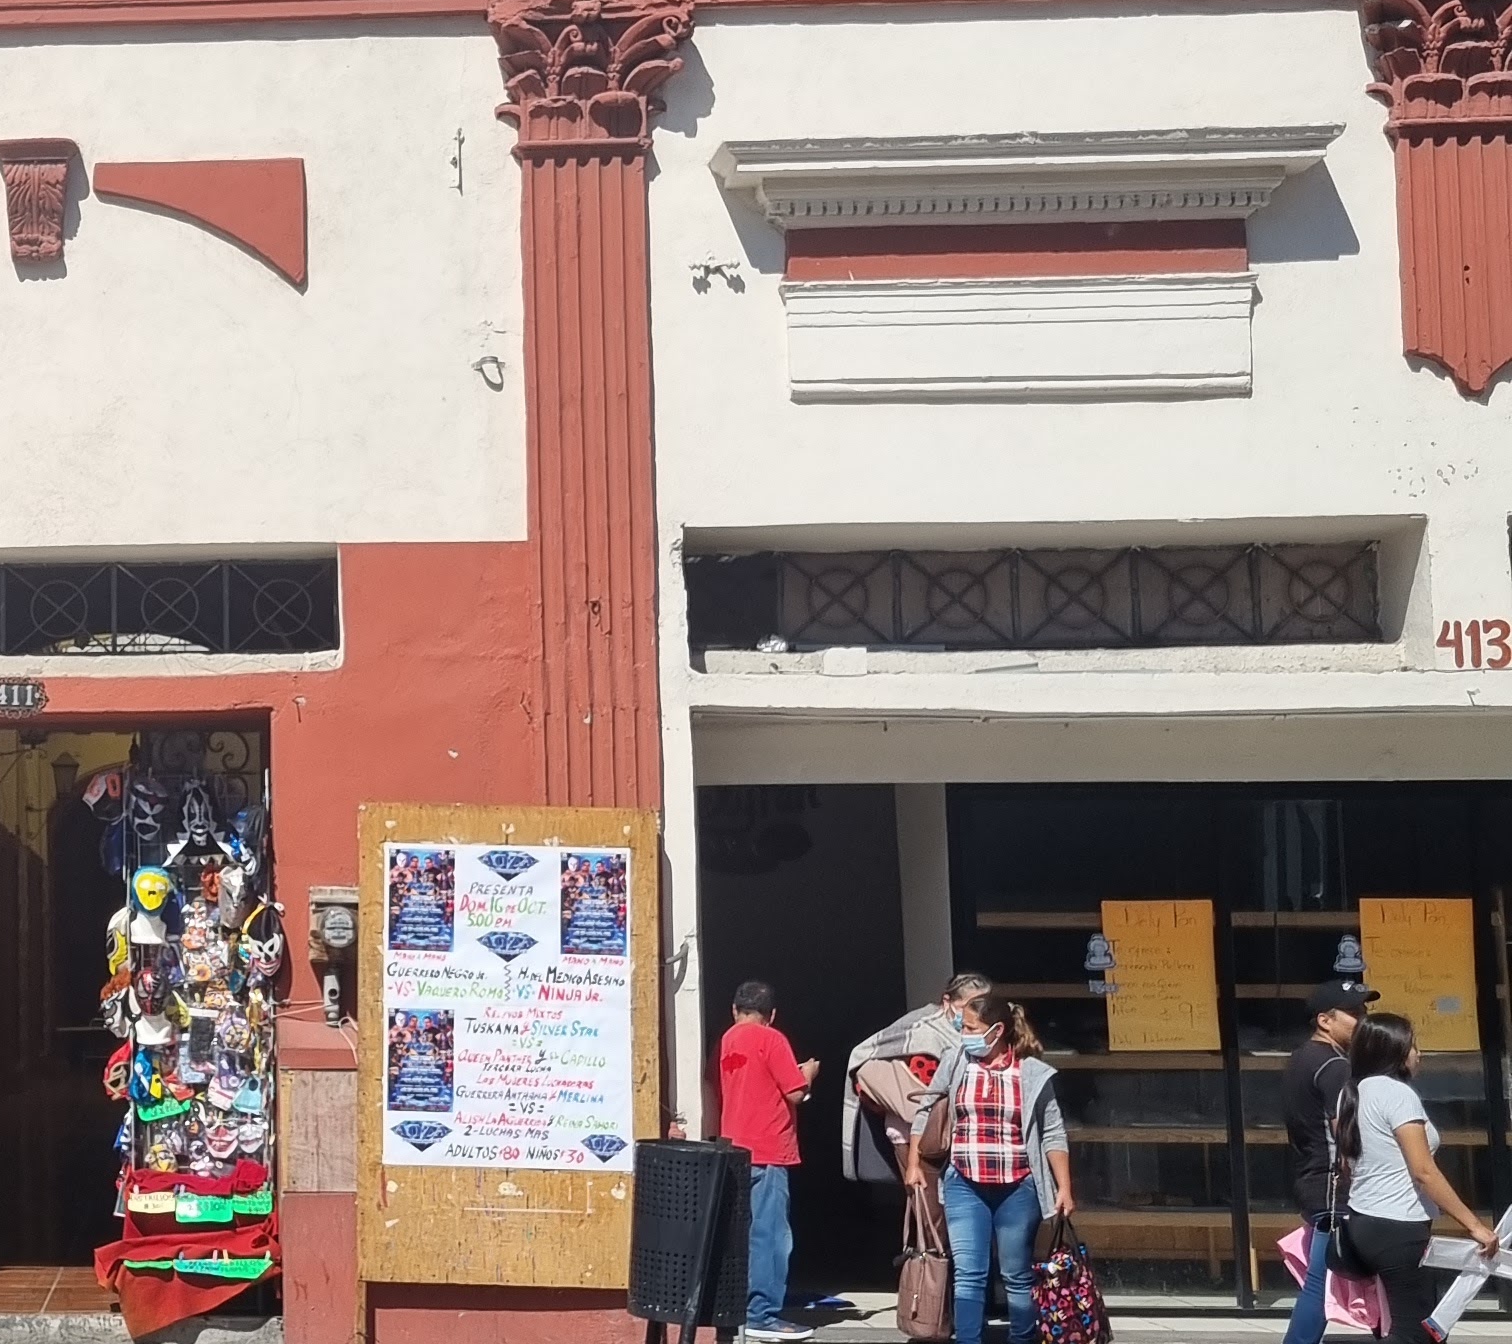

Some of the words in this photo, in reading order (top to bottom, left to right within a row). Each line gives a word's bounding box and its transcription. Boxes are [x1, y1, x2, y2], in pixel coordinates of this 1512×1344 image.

[1435, 619, 1512, 669] 413
[468, 881, 534, 896] PRESENTA
[489, 895, 504, 913] 16
[417, 980, 468, 997] VAQUERO
[538, 984, 582, 1002] NINJA
[464, 1017, 519, 1035] TUSKANA
[530, 1019, 568, 1037] SILVER
[524, 1126, 550, 1141] MAS
[444, 1143, 499, 1161] ADULTOS
[526, 1145, 561, 1161] NIÑOS
